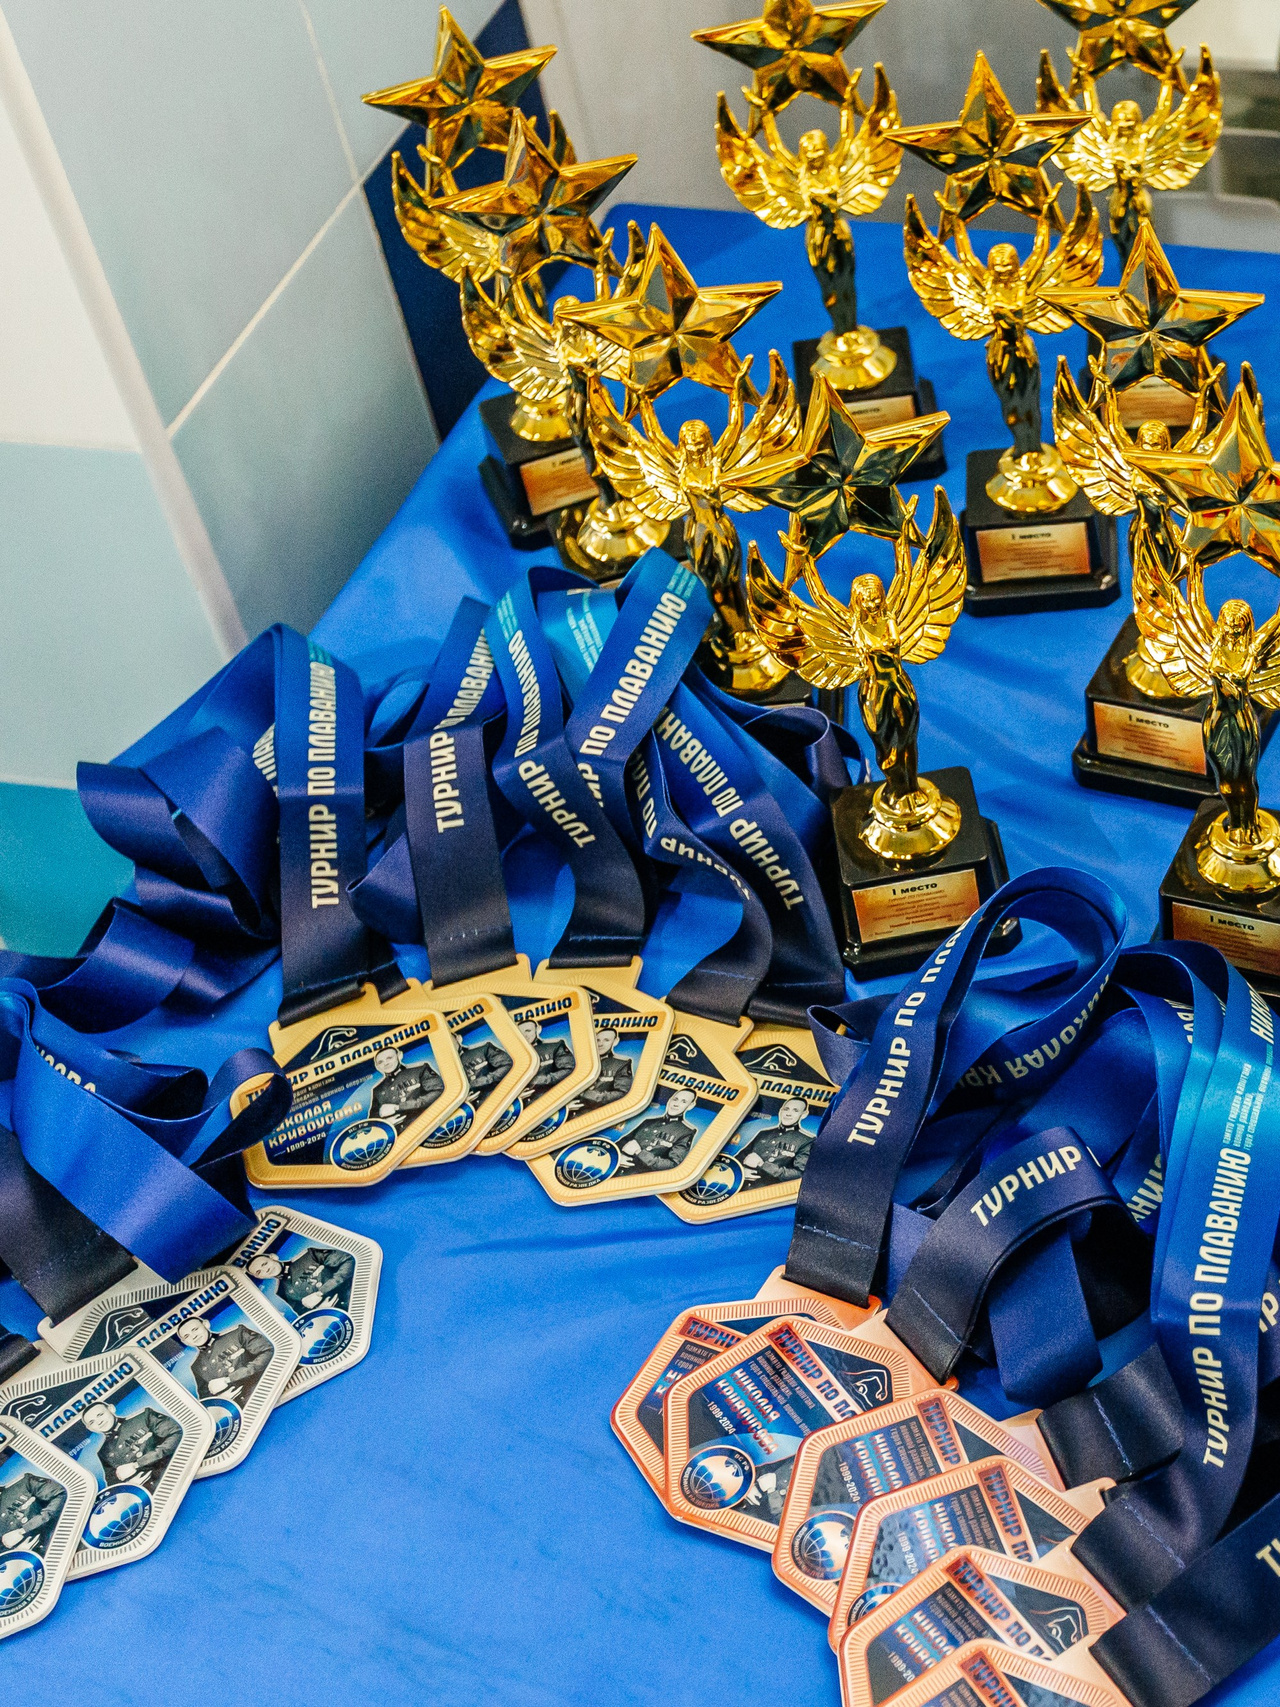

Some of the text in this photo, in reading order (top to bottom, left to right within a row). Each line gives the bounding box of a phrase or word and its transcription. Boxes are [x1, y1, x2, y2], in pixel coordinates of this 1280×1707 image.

[508, 629, 541, 731] ПЛАВАНИЮ
[579, 725, 617, 756] ПО
[600, 591, 688, 723] ПЛАВАНИЮ
[307, 661, 337, 762] ПЛАВАНИЮ
[1136, 717, 1170, 728] место
[514, 728, 540, 758] ПО
[307, 766, 337, 797] ПО
[429, 730, 465, 833] ТУРНИР
[518, 759, 596, 848] ТУРНИР
[655, 707, 804, 911] ТУРНИР ПО ПЛАВАН
[309, 803, 339, 909] ТУРНИР
[642, 797, 752, 901] ТУРНИР ПО
[900, 882, 938, 894] место
[1218, 919, 1255, 931] место
[513, 996, 573, 1022] ВАНИЮ
[594, 1015, 659, 1029] ВАНИЮ
[314, 1019, 431, 1076] ПО ПЛАВАНИЮ
[847, 1036, 912, 1147] ТУРНИР
[894, 991, 926, 1027] ПО
[658, 1069, 740, 1102] ПЛАВАНИЮ
[268, 1102, 363, 1149] КРИВОУСОВА
[272, 1100, 332, 1135] ИКОЛАЯ
[970, 1144, 1083, 1227] ТУРНИР
[233, 1218, 282, 1268] ВАНИЮ
[136, 1279, 230, 1349] ПЛАВАНИЮ
[686, 1320, 741, 1348] ТУРНИ
[1189, 1147, 1253, 1469] ТУРНИР ПО ПЛАВАНИЮ
[775, 1329, 840, 1402] ТУРНИР ПО
[39, 1361, 134, 1438] ПЛАВАНИЮ
[707, 1400, 736, 1435] 1999-2024
[714, 1379, 779, 1455] КРИВОУСОВА
[729, 1368, 781, 1424] НИКОЛАЯ
[868, 1433, 904, 1490] НИКОЛА
[922, 1402, 961, 1465] ТУРНИР
[838, 1461, 861, 1503] 1999-2024
[983, 1470, 1023, 1537] ТУРНИР
[896, 1530, 921, 1575] 1999-2024
[953, 1561, 1032, 1647] ТУРНИР ПО
[887, 1651, 916, 1683] 1999-20
